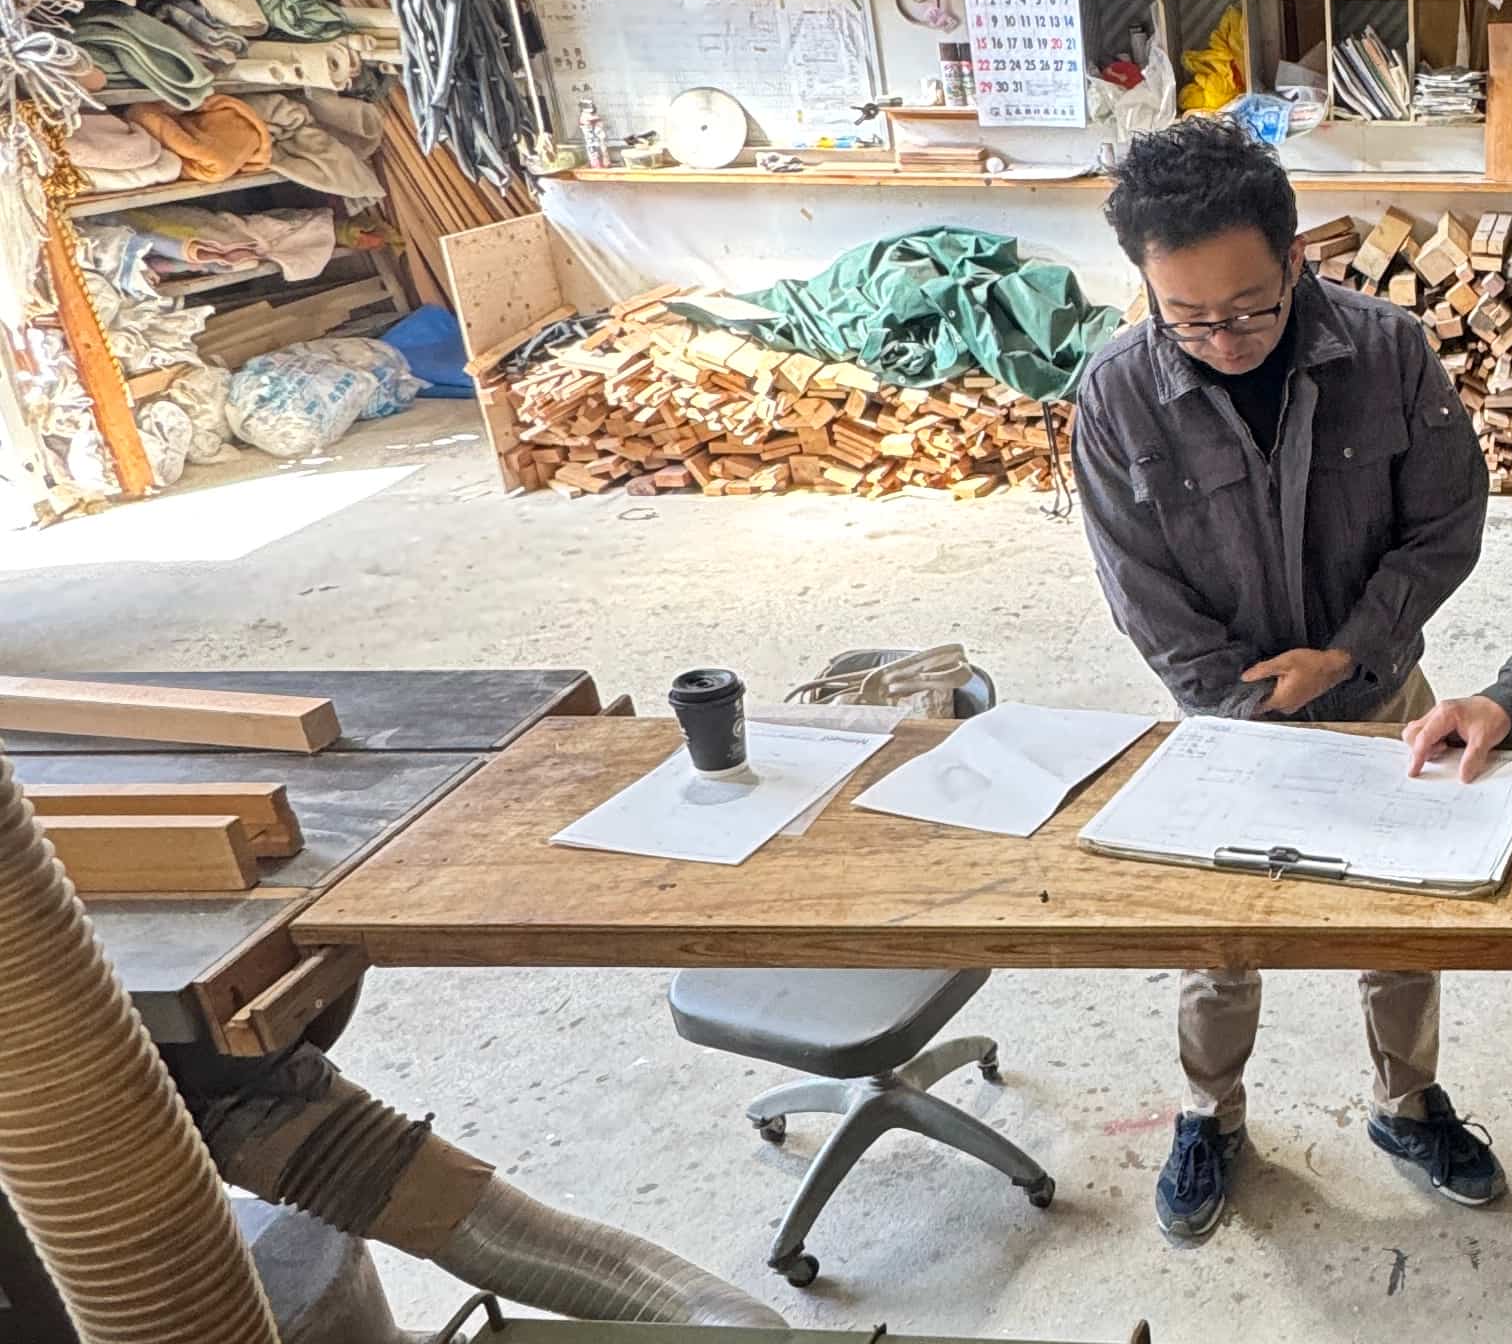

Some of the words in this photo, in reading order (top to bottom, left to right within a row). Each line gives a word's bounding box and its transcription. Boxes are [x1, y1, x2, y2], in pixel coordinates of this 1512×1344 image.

[992, 15, 998, 27] 9
[1005, 15, 1016, 27] 10
[1020, 15, 1031, 27] 11
[1036, 15, 1046, 27] 12
[1050, 15, 1060, 27] 13
[1064, 15, 1074, 27] 14
[976, 38, 987, 50] 15
[992, 38, 1003, 50] 16
[1008, 38, 1017, 50] 17
[1023, 38, 1033, 50] 18
[1037, 38, 1048, 50] 19
[1051, 38, 1063, 50] 20
[1066, 38, 1076, 50] 21
[979, 60, 990, 72] 22
[994, 60, 1006, 72] 23
[1009, 60, 1021, 72] 24
[1024, 60, 1036, 72] 25
[1040, 60, 1050, 72] 26
[1054, 60, 1063, 72] 27
[980, 81, 992, 92] 29
[996, 81, 1008, 92] 30
[1013, 81, 1022, 92] 31
